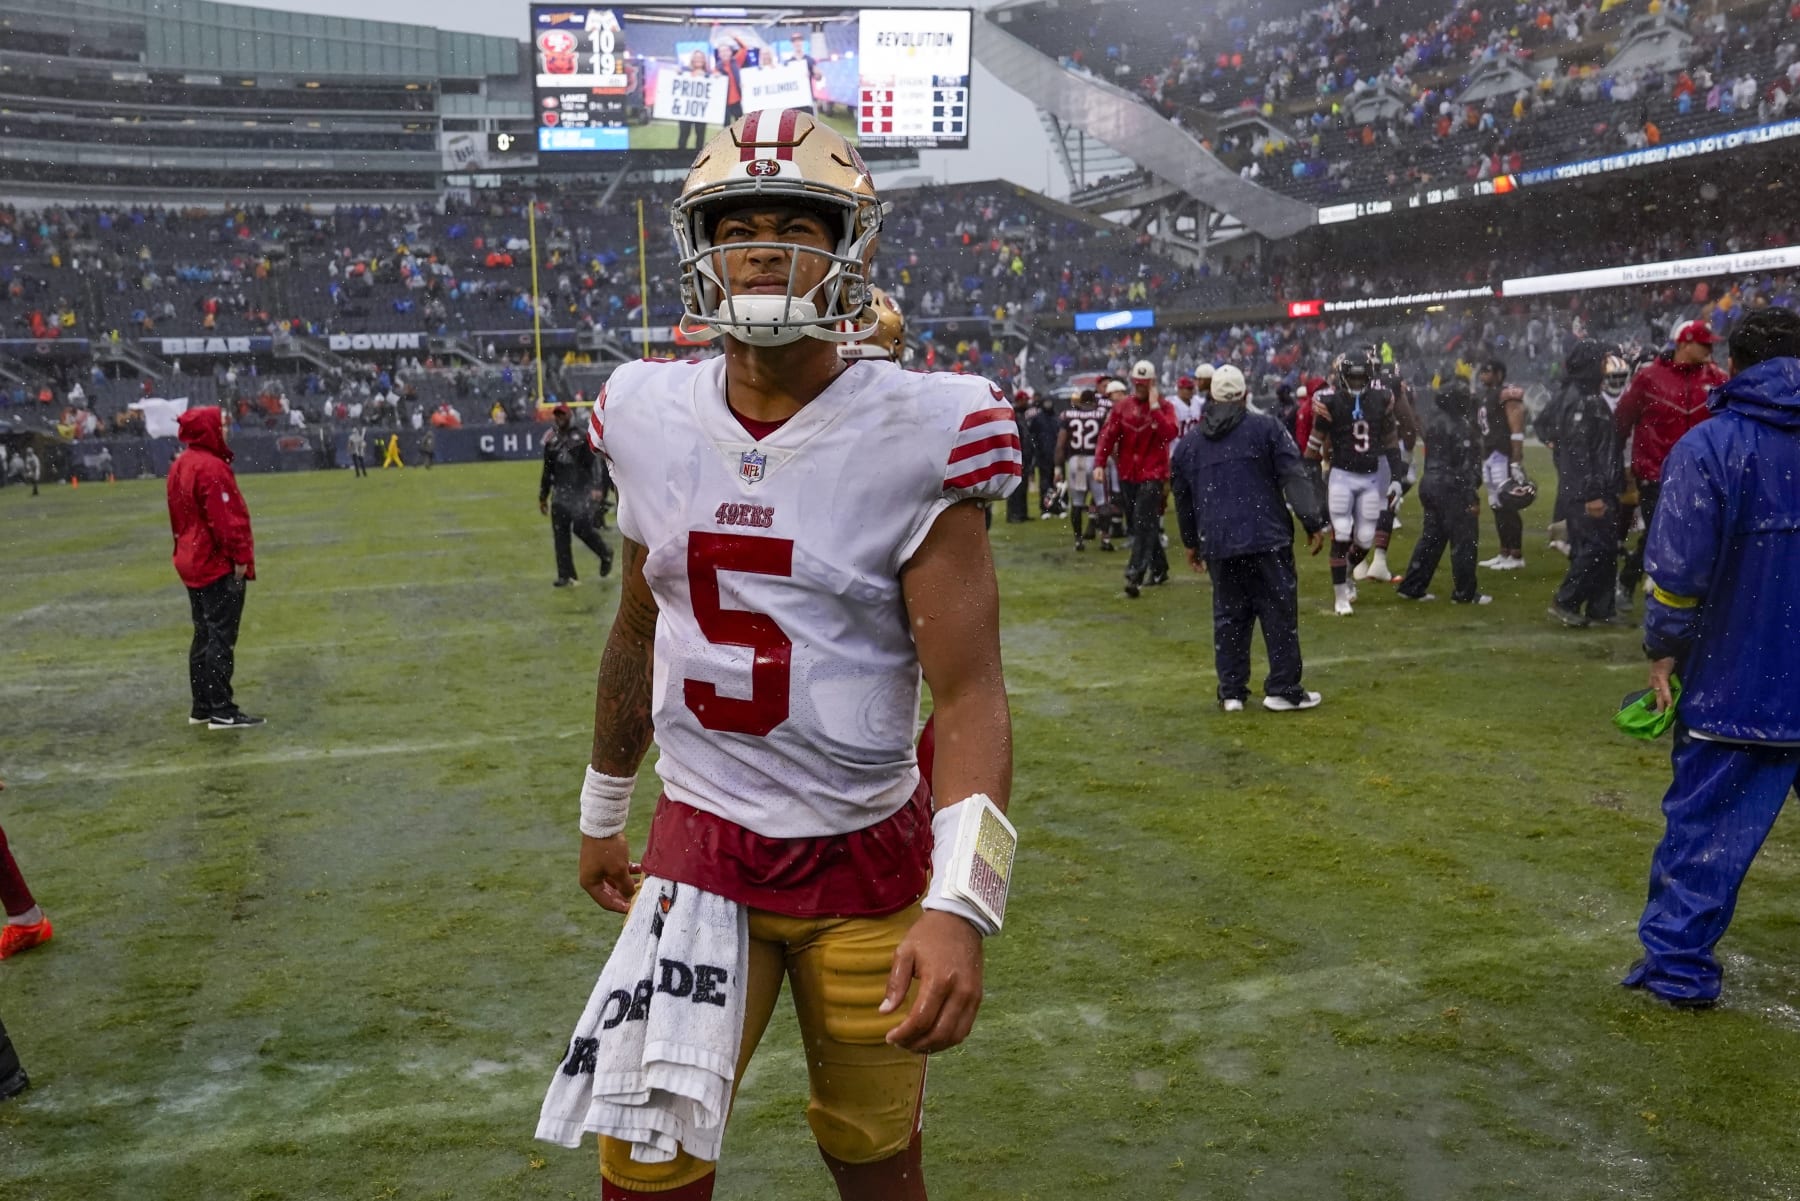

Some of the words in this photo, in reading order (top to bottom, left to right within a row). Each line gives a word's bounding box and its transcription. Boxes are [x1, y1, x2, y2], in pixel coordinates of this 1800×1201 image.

[588, 30, 615, 53] 10
[876, 31, 954, 47] REVOLUTION
[589, 53, 616, 75] 19
[672, 79, 712, 99] PRIDE
[765, 81, 799, 96] ILLINOIS
[672, 99, 683, 116] &
[685, 101, 709, 117] JOY
[1627, 147, 1666, 168] PRIDE
[1667, 142, 1696, 159] AND
[1700, 136, 1724, 154] JOY
[1622, 271, 1632, 281] In
[1636, 267, 1669, 280] Game
[1672, 259, 1731, 276] Receiving
[1735, 254, 1785, 270] Leaders
[1324, 302, 1334, 312] We
[1336, 301, 1355, 311] shape
[1356, 299, 1367, 309] the
[1368, 297, 1390, 307] future
[1391, 295, 1398, 305] of
[1399, 294, 1412, 304] real
[1412, 292, 1431, 303] estate
[1432, 290, 1442, 301] for
[1448, 289, 1469, 299] better
[161, 337, 250, 354] BEAR
[329, 333, 419, 350] DOWN
[1069, 418, 1099, 449] 32
[1353, 419, 1371, 453] 9
[743, 463, 761, 478] NFL
[714, 502, 776, 529] 49ERS
[682, 530, 795, 737] 5
